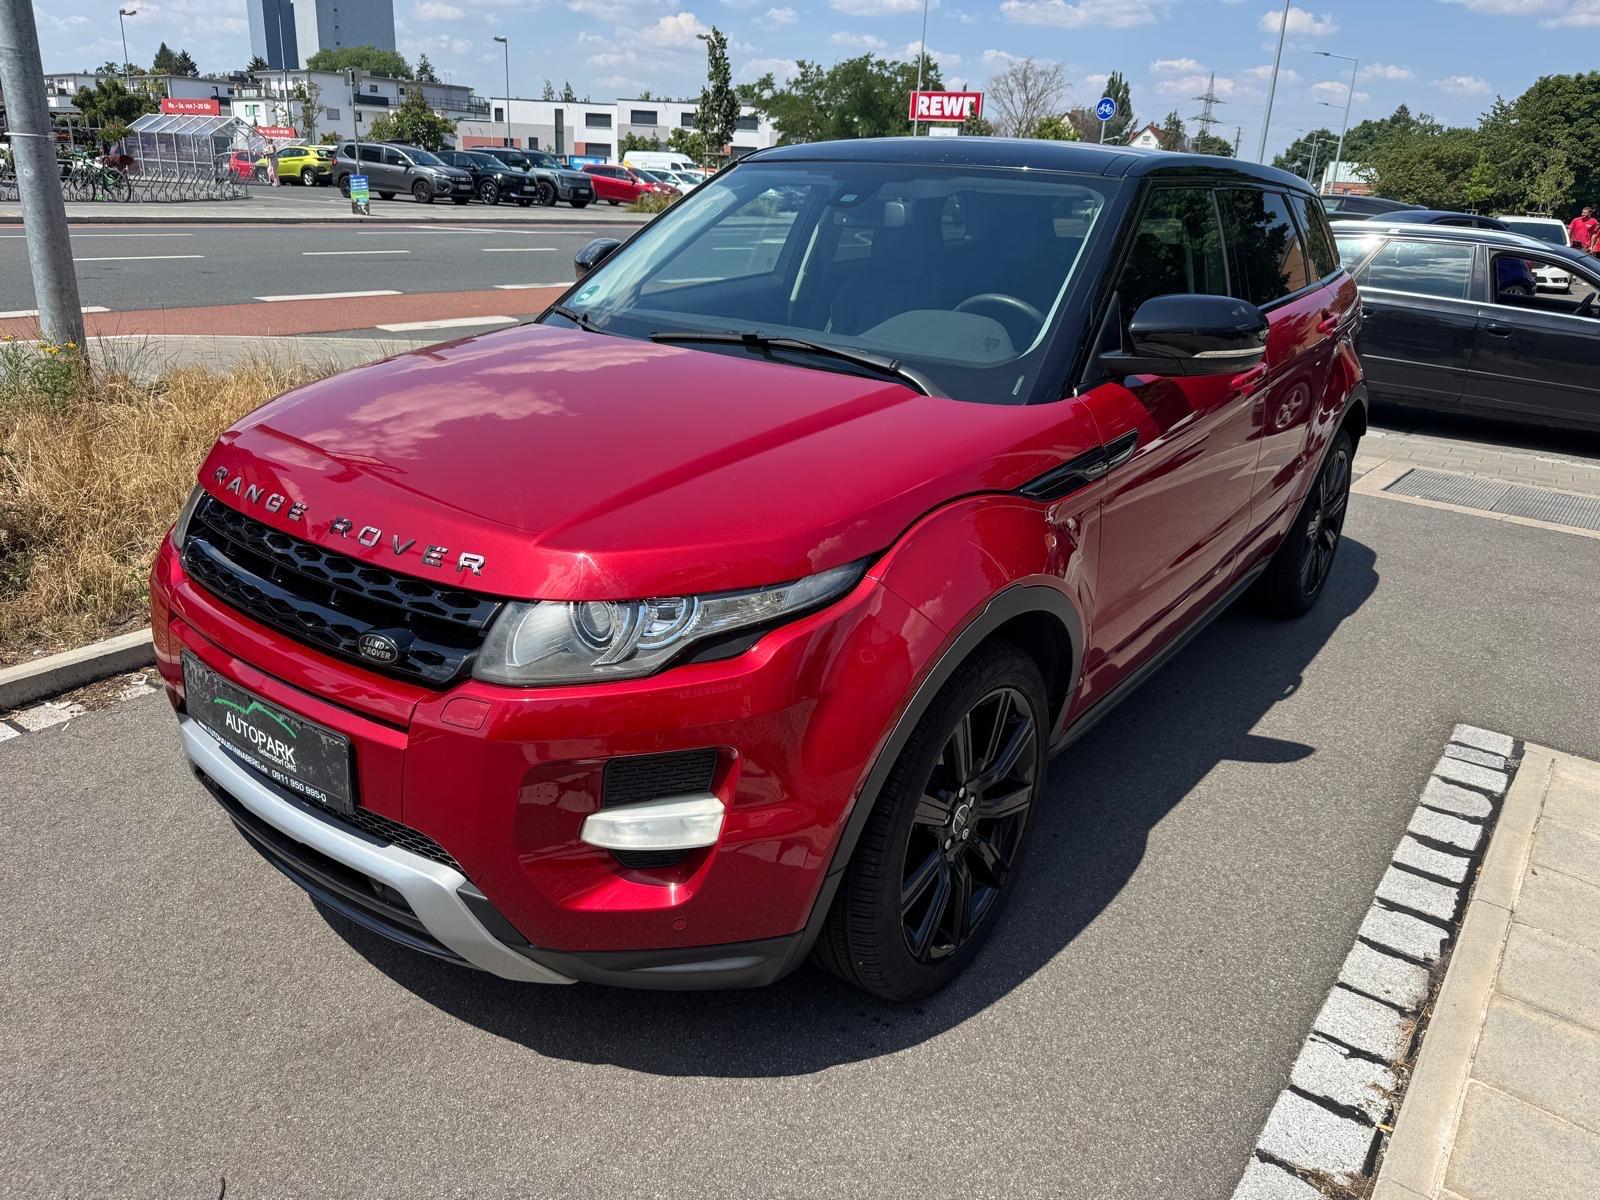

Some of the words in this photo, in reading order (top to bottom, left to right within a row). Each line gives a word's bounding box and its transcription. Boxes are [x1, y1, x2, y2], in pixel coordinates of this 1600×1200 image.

[214, 466, 308, 522] RANGE
[329, 517, 486, 576] ROVER
[365, 637, 385, 649] LAND
[366, 647, 391, 660] ROVER
[225, 711, 296, 764] AUTOPARK
[257, 746, 284, 766] Gebersdorf
[284, 761, 297, 773] OHG
[271, 769, 289, 784] 0911
[290, 779, 305, 792] 950
[305, 786, 327, 802] 995-0
